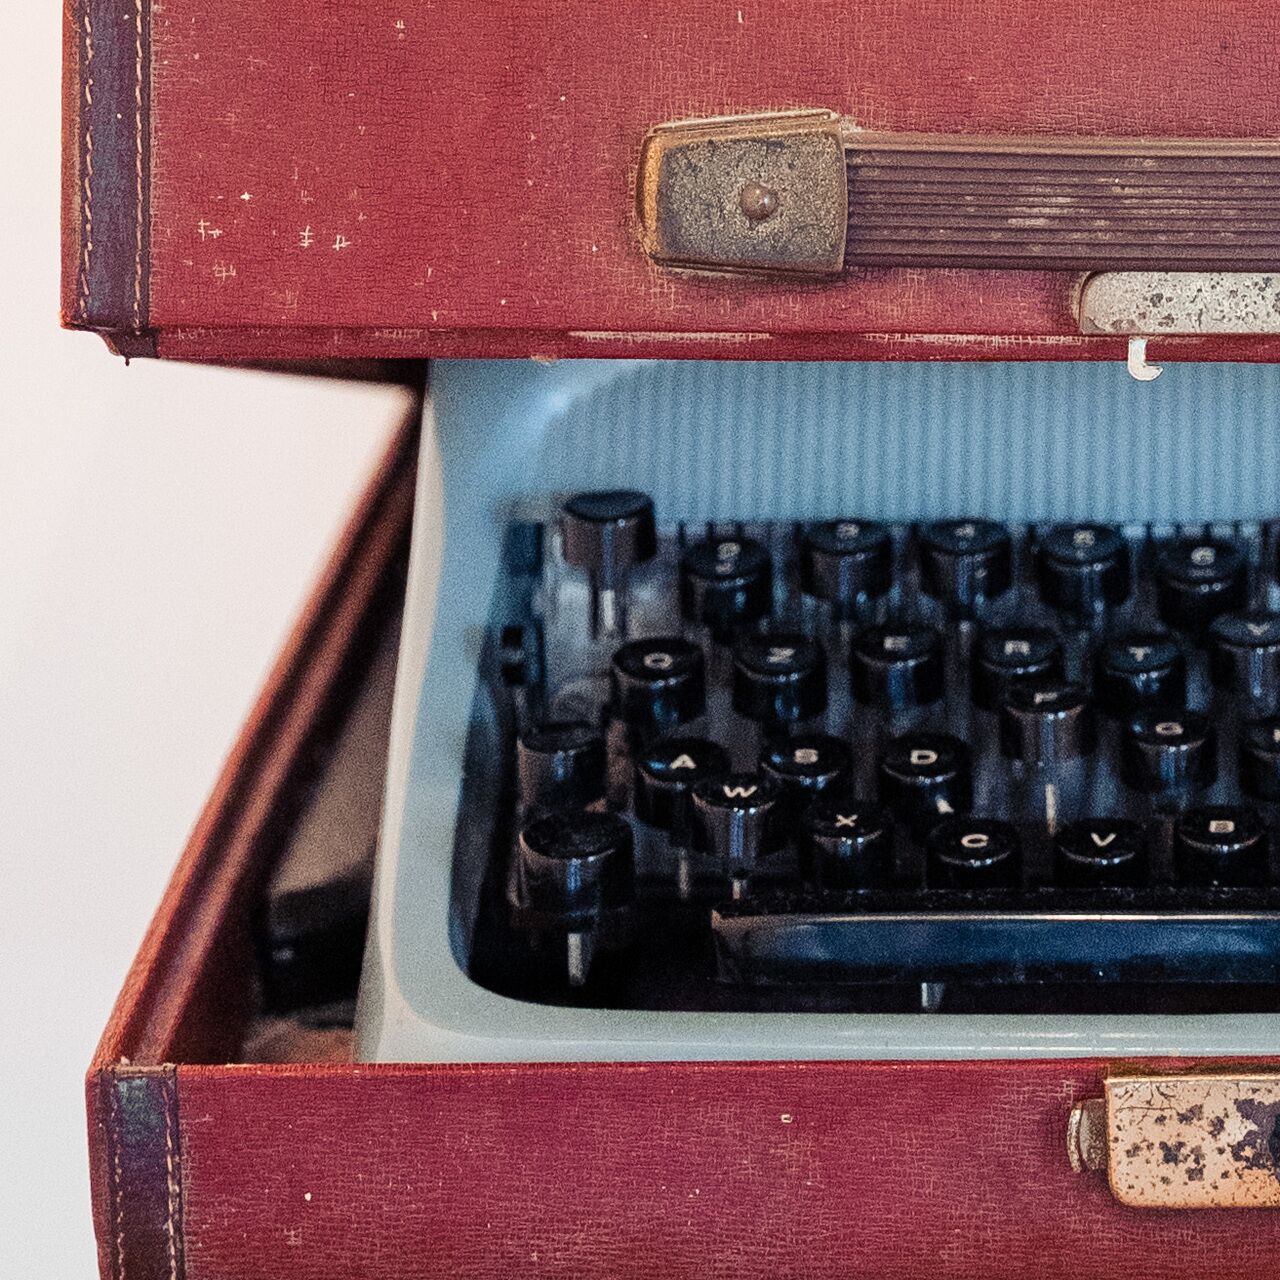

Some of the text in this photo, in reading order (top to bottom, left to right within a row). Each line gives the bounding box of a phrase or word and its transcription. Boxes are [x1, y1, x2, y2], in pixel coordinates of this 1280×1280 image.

[669, 753, 696, 770] A
[909, 749, 938, 765] D
[722, 784, 758, 799] W
[834, 814, 858, 828] X
[960, 833, 989, 849] C
[1090, 832, 1117, 847] V
